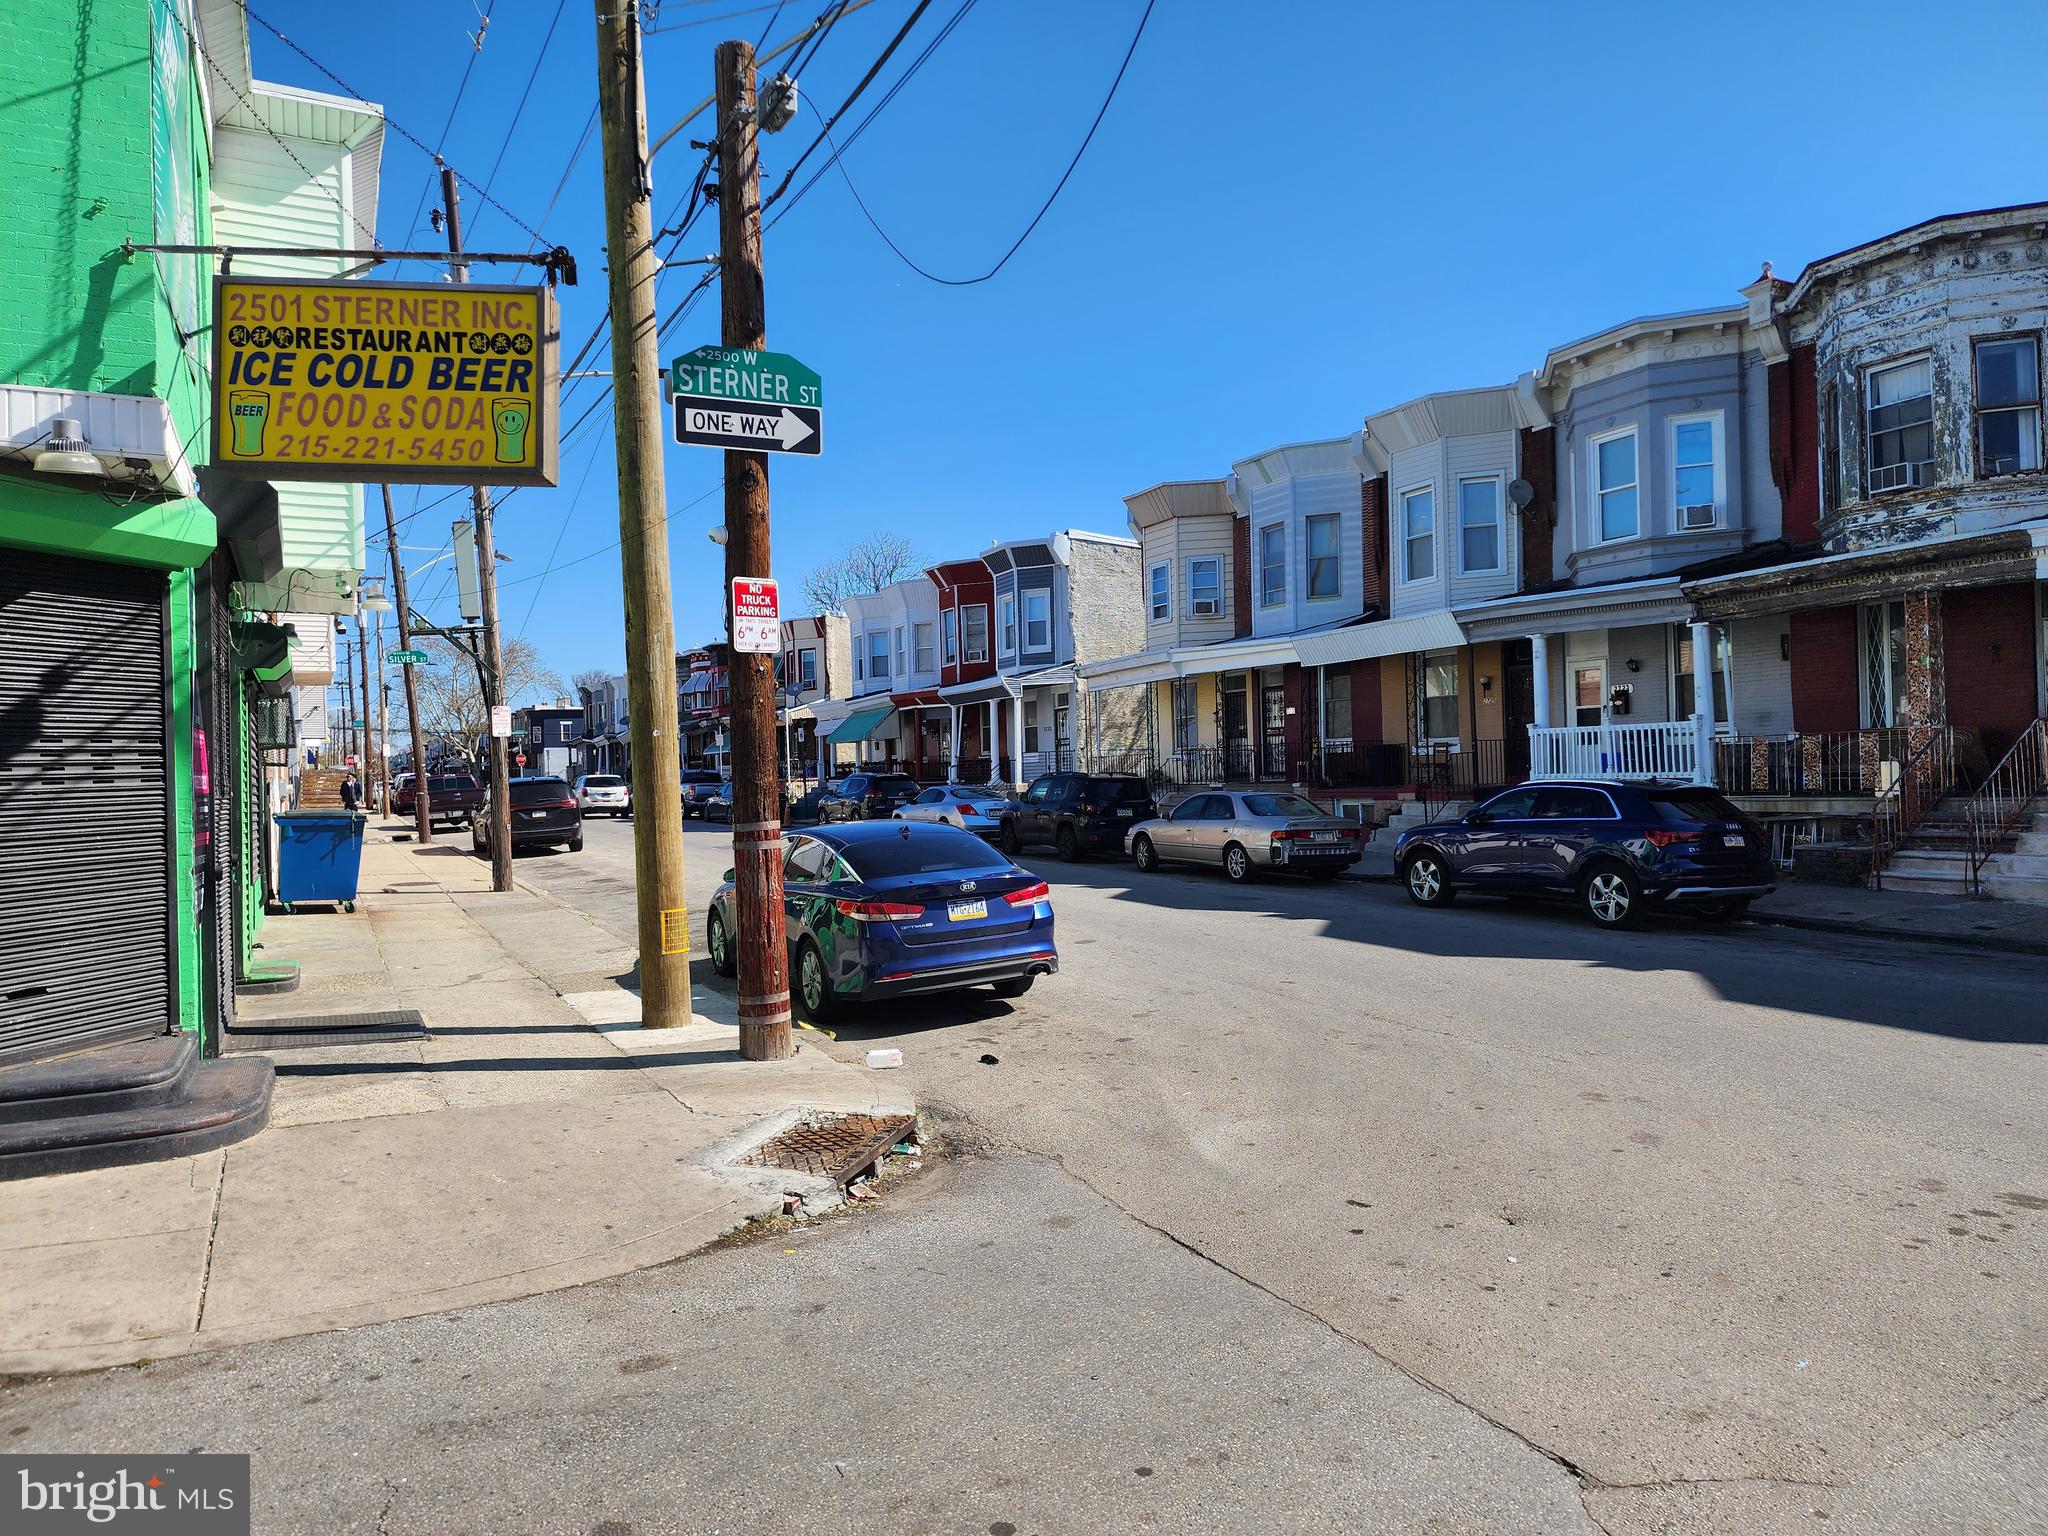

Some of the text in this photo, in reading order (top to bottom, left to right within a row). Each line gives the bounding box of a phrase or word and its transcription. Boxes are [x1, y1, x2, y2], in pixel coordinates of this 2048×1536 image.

[230, 293, 532, 330] 2501 STERNER INC.
[295, 327, 467, 353] RESTAURANT
[707, 349, 758, 366] 2500 W
[228, 351, 534, 392] ICE COLD BEER
[679, 364, 817, 404] STERNER ST
[234, 405, 264, 417] BEER
[275, 391, 486, 431] FOOD & SODA
[693, 412, 779, 436] ONE WAY
[275, 434, 485, 462] 215-221-5450
[741, 594, 771, 605] TRUCK
[749, 584, 762, 594] NO
[737, 605, 776, 617] PARKING
[389, 655, 417, 663] SILVER
